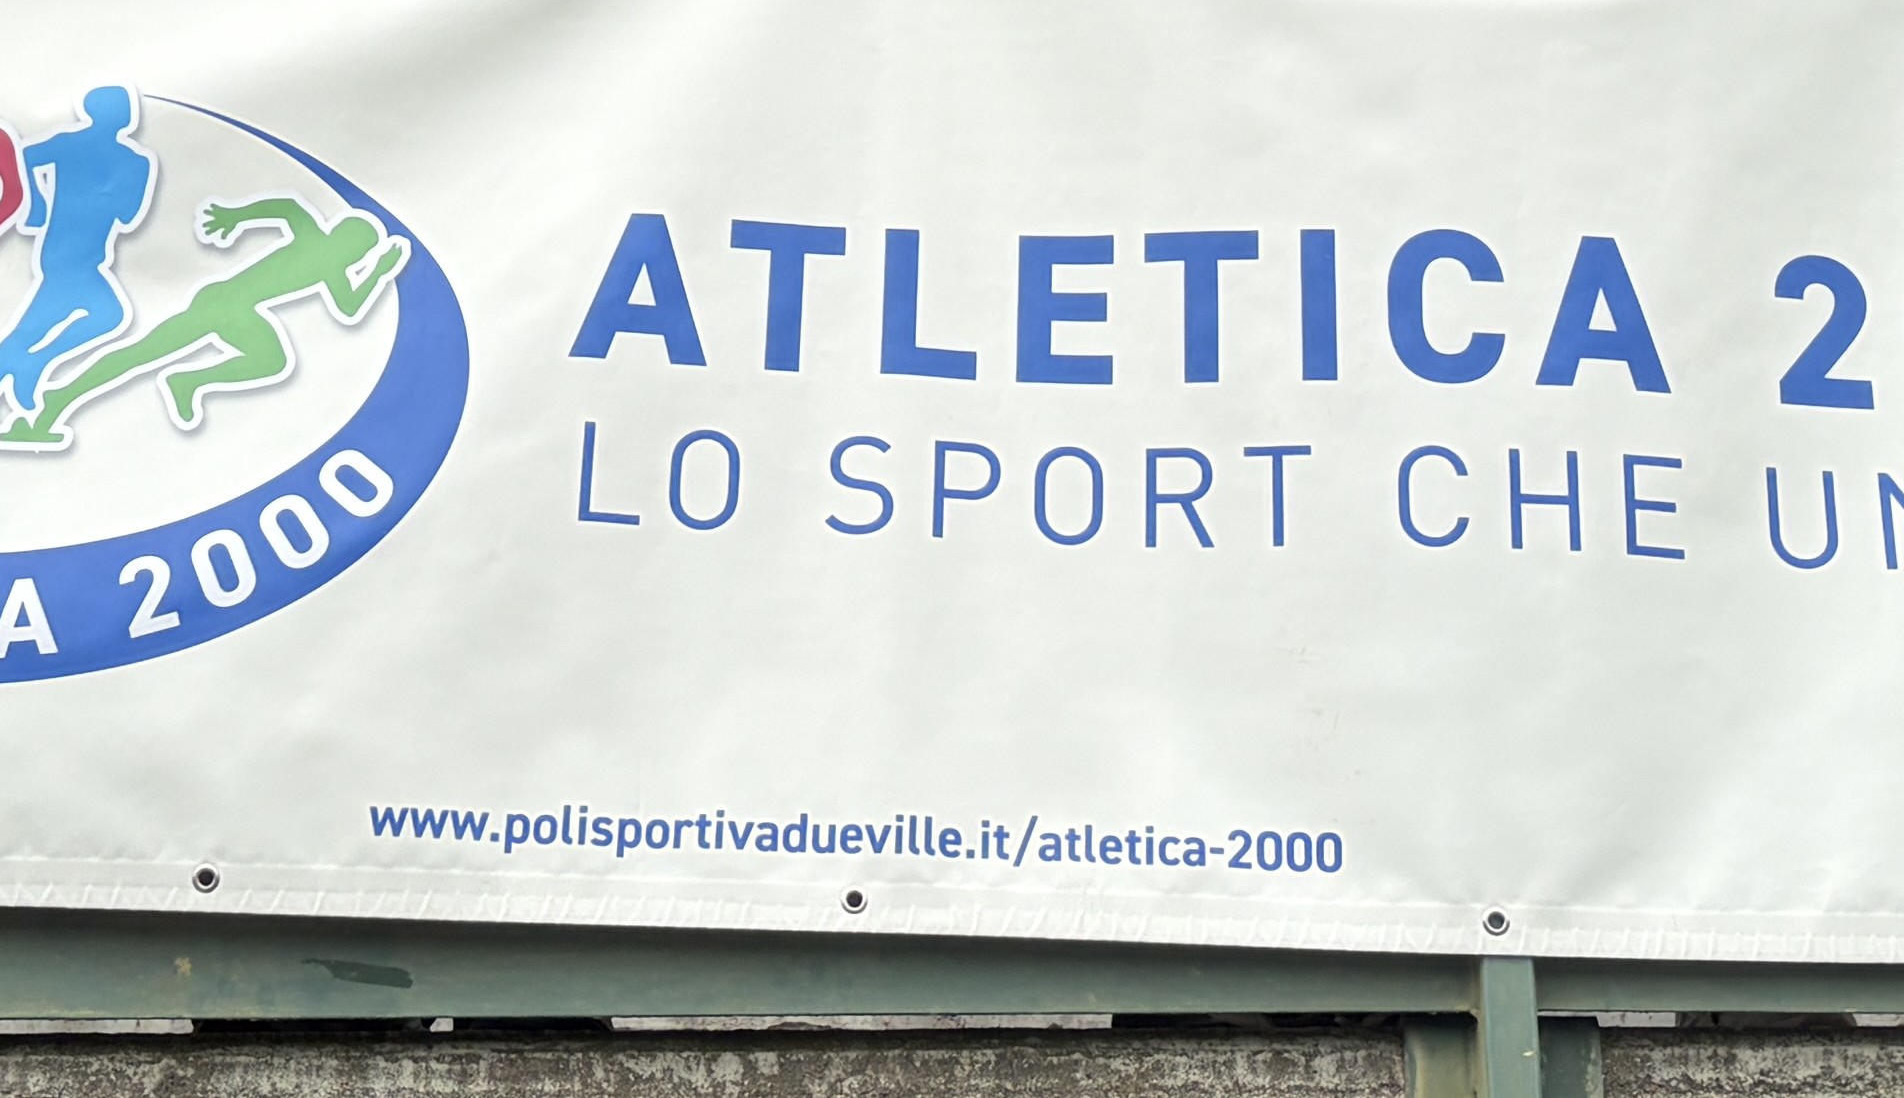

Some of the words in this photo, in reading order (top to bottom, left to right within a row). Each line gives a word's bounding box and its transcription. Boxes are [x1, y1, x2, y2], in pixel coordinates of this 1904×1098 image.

[567, 212, 1673, 394] ATLETICA
[118, 446, 395, 639] 2000
[577, 420, 741, 532] LO
[824, 434, 1312, 550] SPORT
[1397, 443, 1686, 561] CHE
[368, 799, 1345, 875] www.polisportivadueville.it/atletica-2000
